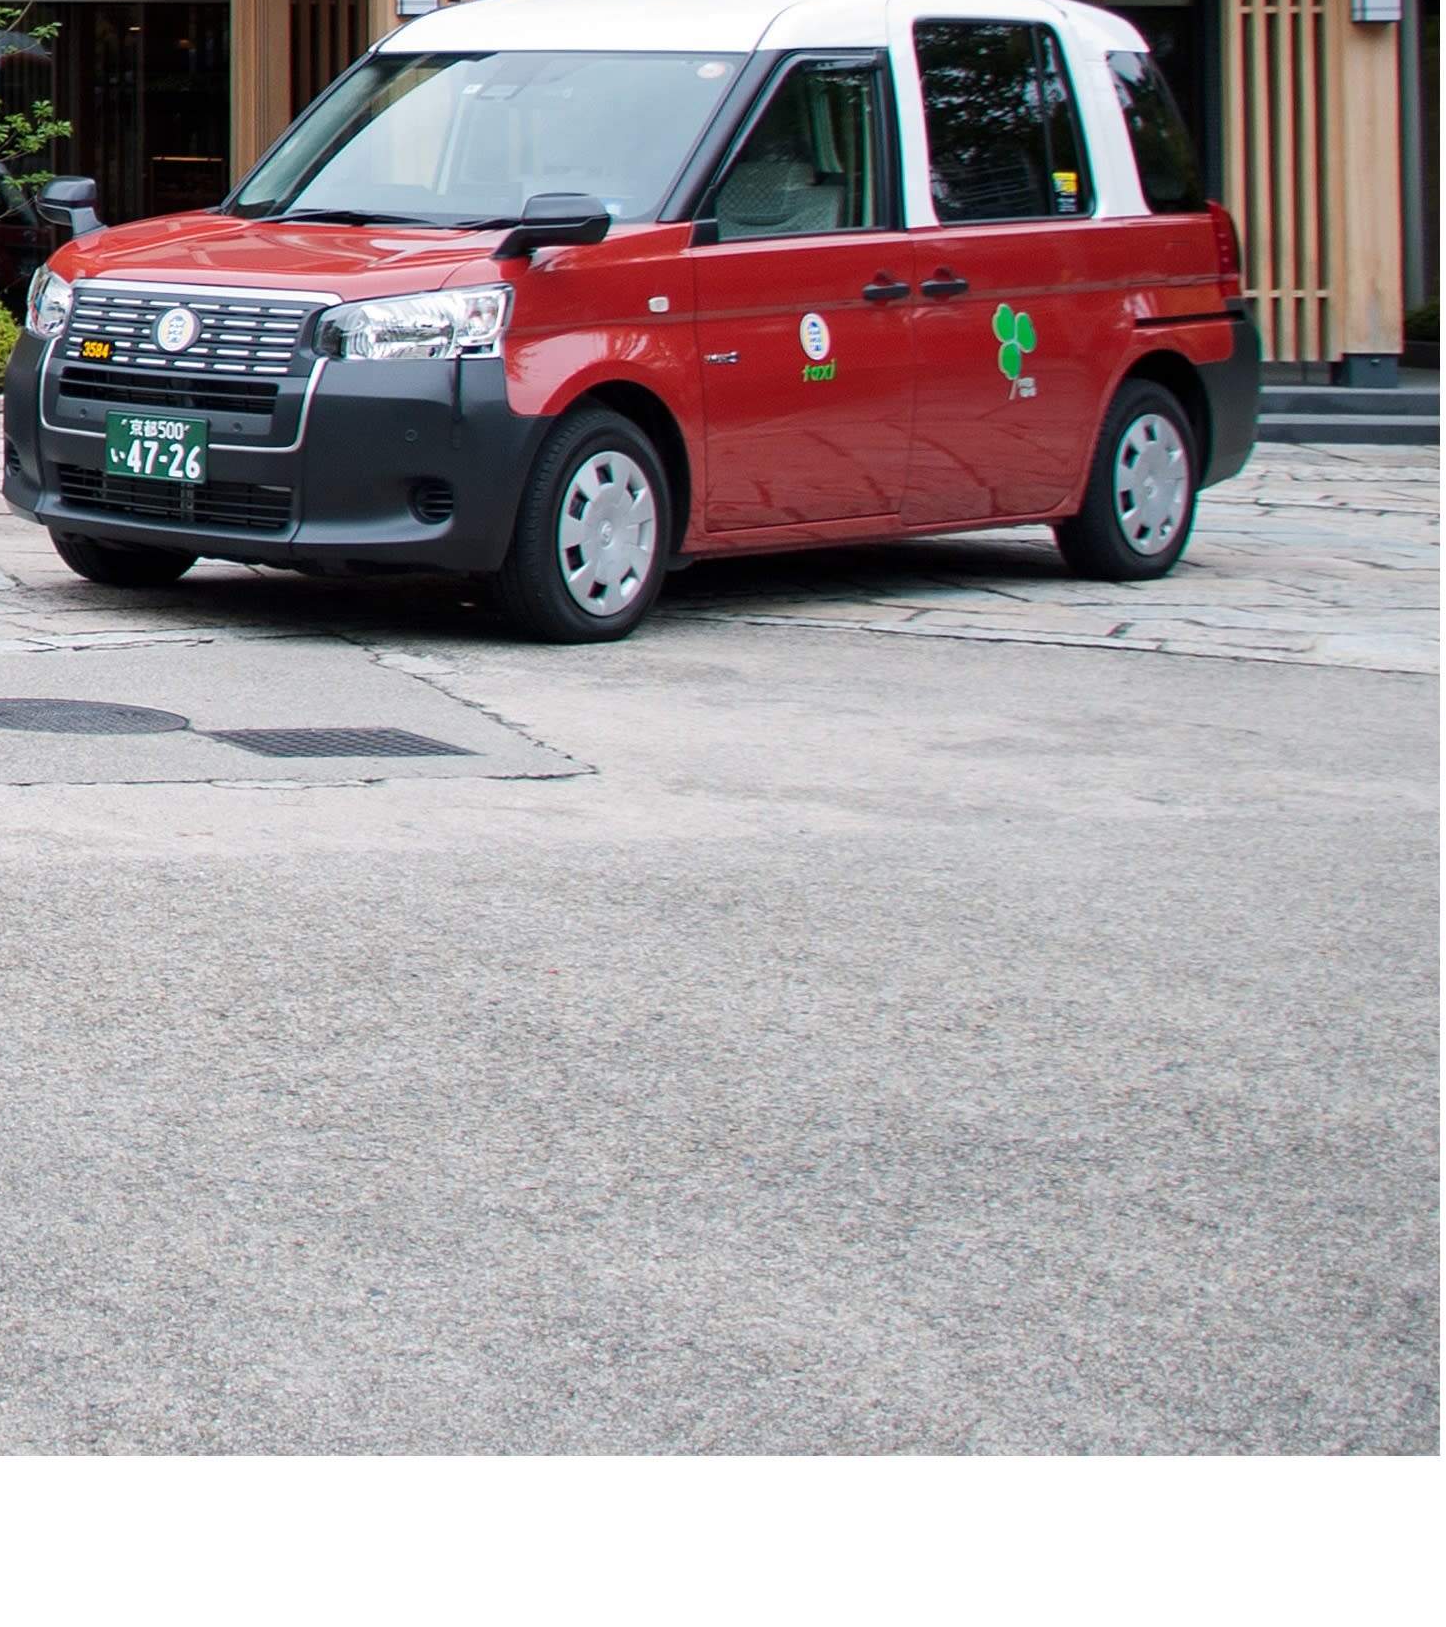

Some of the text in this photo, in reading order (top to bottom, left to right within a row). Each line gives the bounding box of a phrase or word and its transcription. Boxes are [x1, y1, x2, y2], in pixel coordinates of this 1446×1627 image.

[82, 341, 110, 358] 3584
[801, 358, 837, 383] taxi
[127, 439, 201, 479] 47-26
